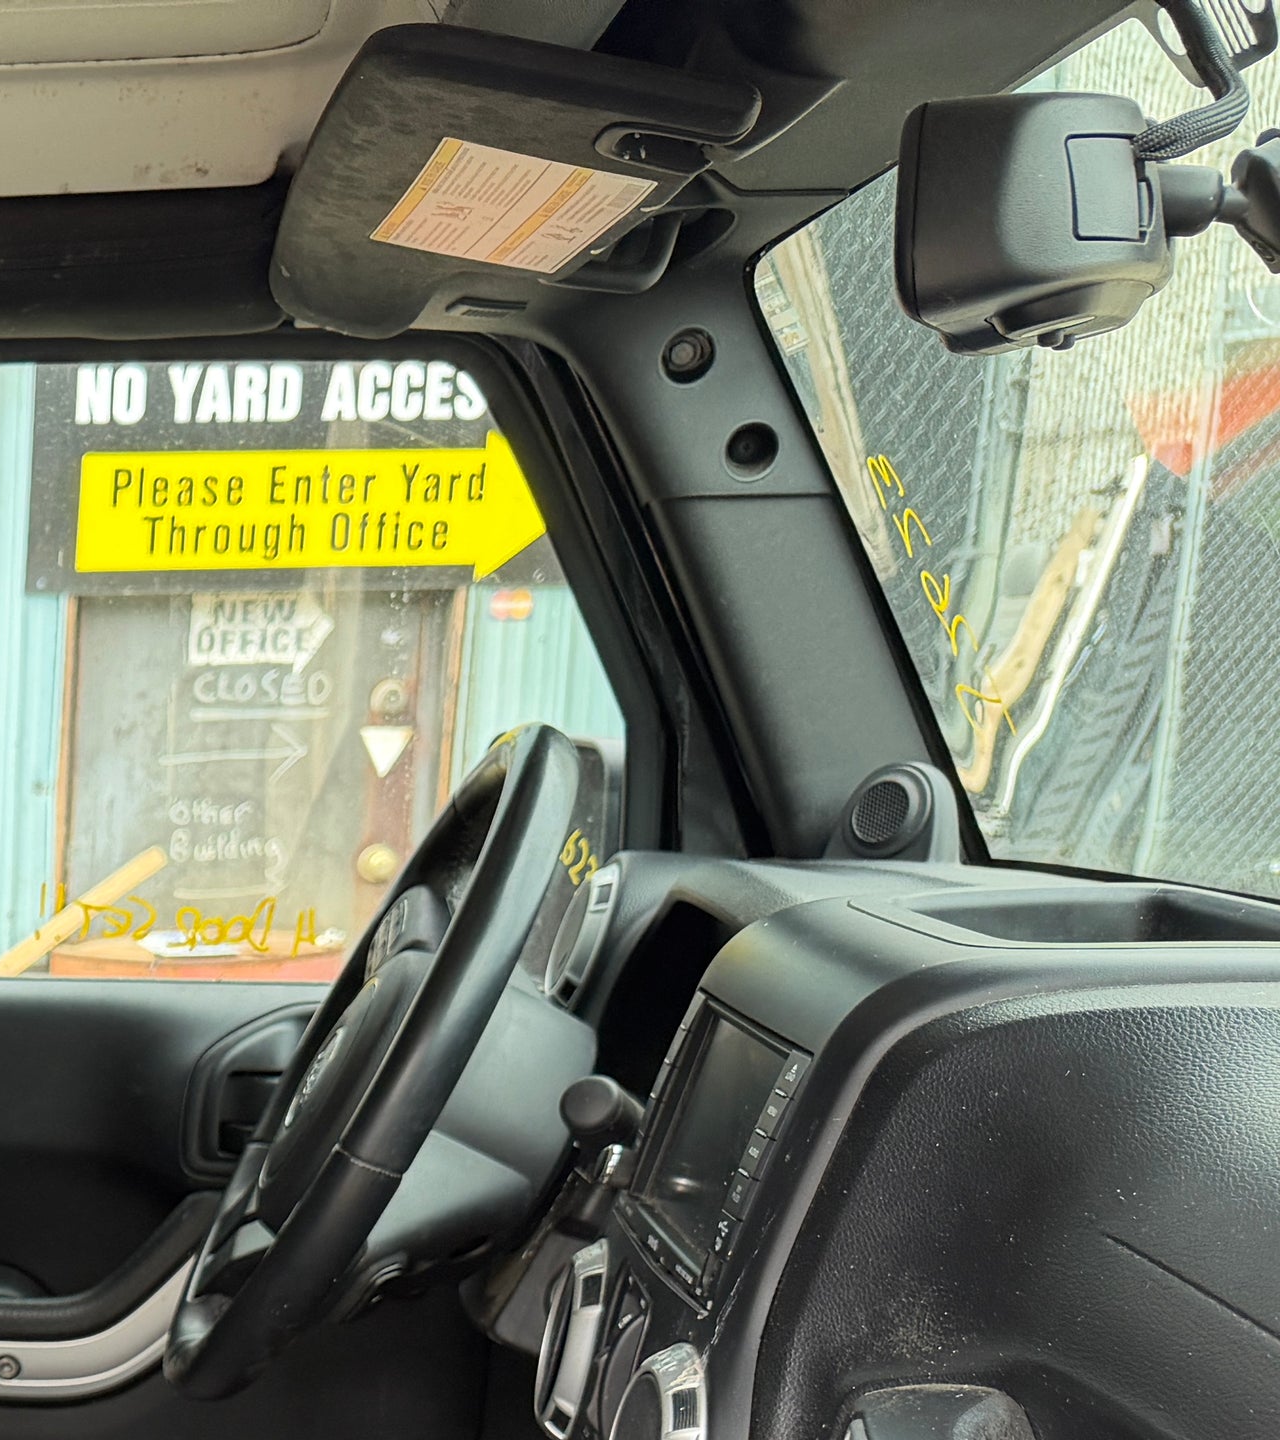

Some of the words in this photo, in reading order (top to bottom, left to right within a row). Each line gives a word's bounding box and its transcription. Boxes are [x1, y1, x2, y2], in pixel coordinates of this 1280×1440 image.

[74, 362, 147, 425] NO
[166, 362, 303, 424] YARD
[320, 359, 488, 421] ACCES
[111, 465, 245, 509] Please
[268, 463, 376, 505] Enter
[400, 462, 487, 504] Yard
[142, 512, 307, 561] Through
[330, 511, 450, 552] Office
[212, 598, 298, 625] NEW
[196, 627, 309, 656] OFFICE
[193, 669, 333, 705] CLOSED
